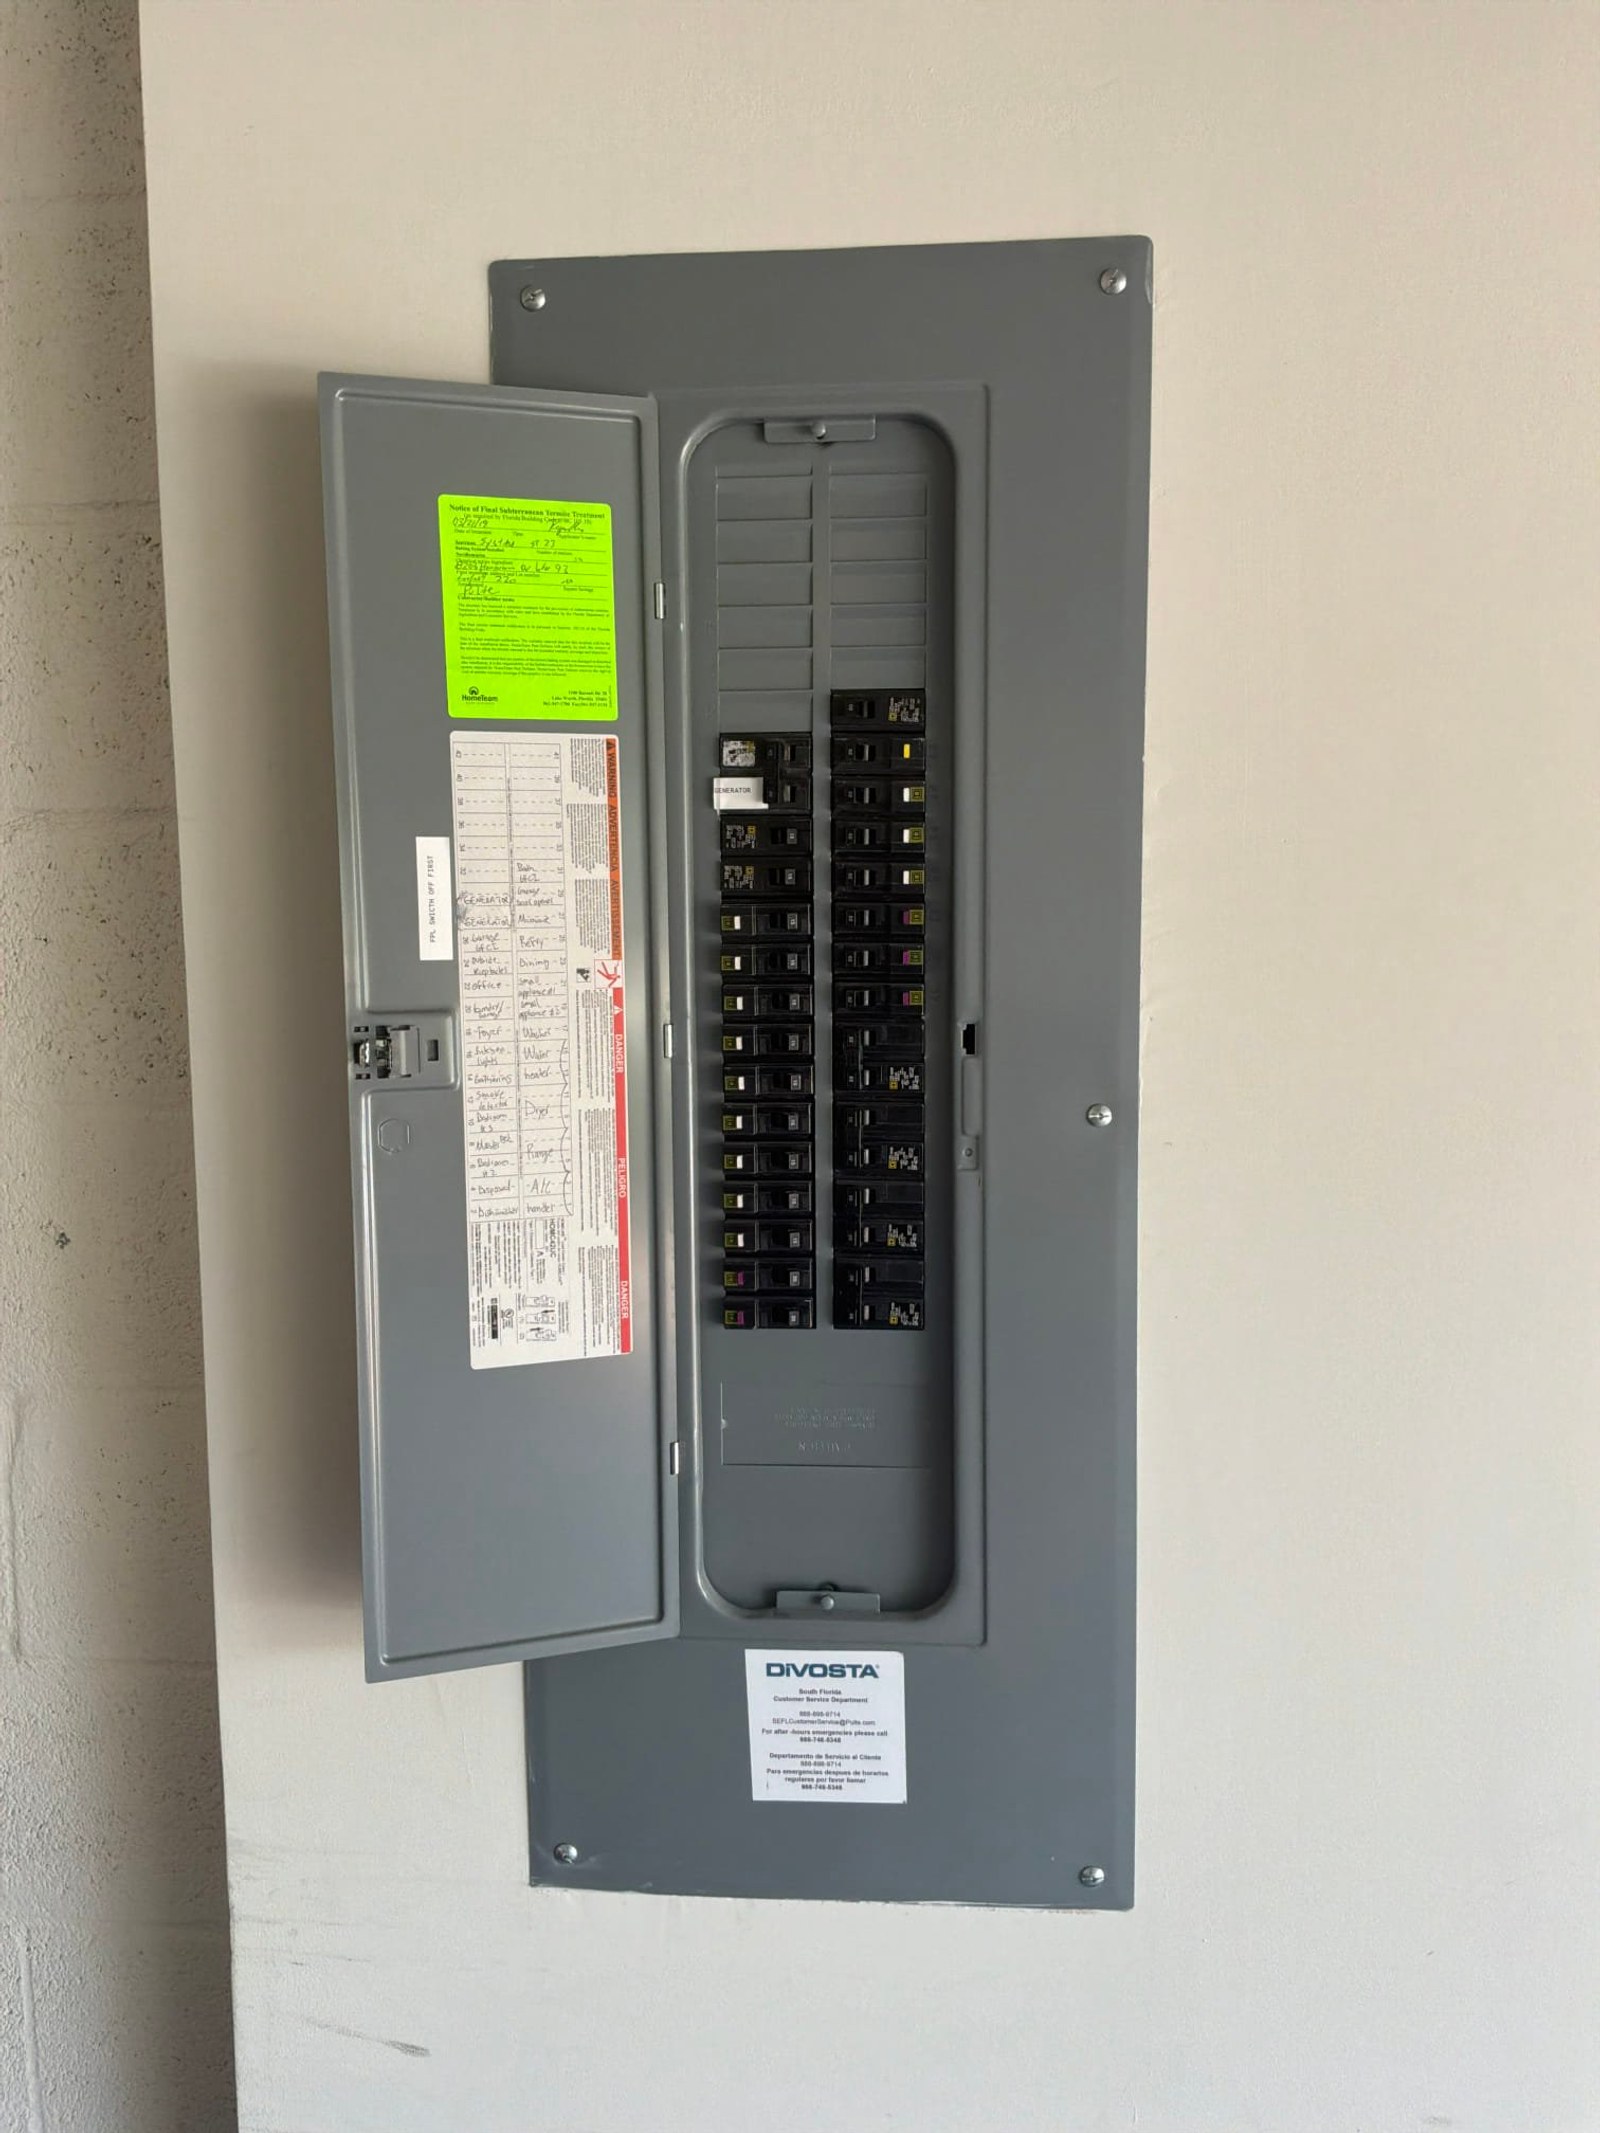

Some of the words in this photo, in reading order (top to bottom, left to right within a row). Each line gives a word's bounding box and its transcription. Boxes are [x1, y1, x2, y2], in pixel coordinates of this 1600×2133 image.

[449, 504, 470, 512] Notice
[500, 507, 544, 516] Subterranean
[462, 694, 498, 702] HomeTeam
[608, 752, 618, 798] WARNING
[714, 786, 752, 794] GENERATOR
[609, 804, 620, 872] ADVERTENCIA
[428, 898, 436, 926] SWICTH
[610, 879, 620, 959] AVERTISSEMENT
[520, 958, 550, 970] Dining
[524, 1045, 549, 1060] Water
[614, 1033, 624, 1074] DANGER
[524, 1100, 550, 1120] Dryer
[618, 1157, 626, 1198] PELIGRO
[530, 1178, 551, 1194] A/C
[620, 1280, 629, 1319] DANGER
[766, 1662, 879, 1678] DiVOSTA
[820, 1688, 842, 1696] Florida
[831, 1696, 868, 1704] Department
[769, 1752, 814, 1760] Departamento
[784, 1776, 814, 1784] regulares
[828, 1776, 844, 1784] favor
